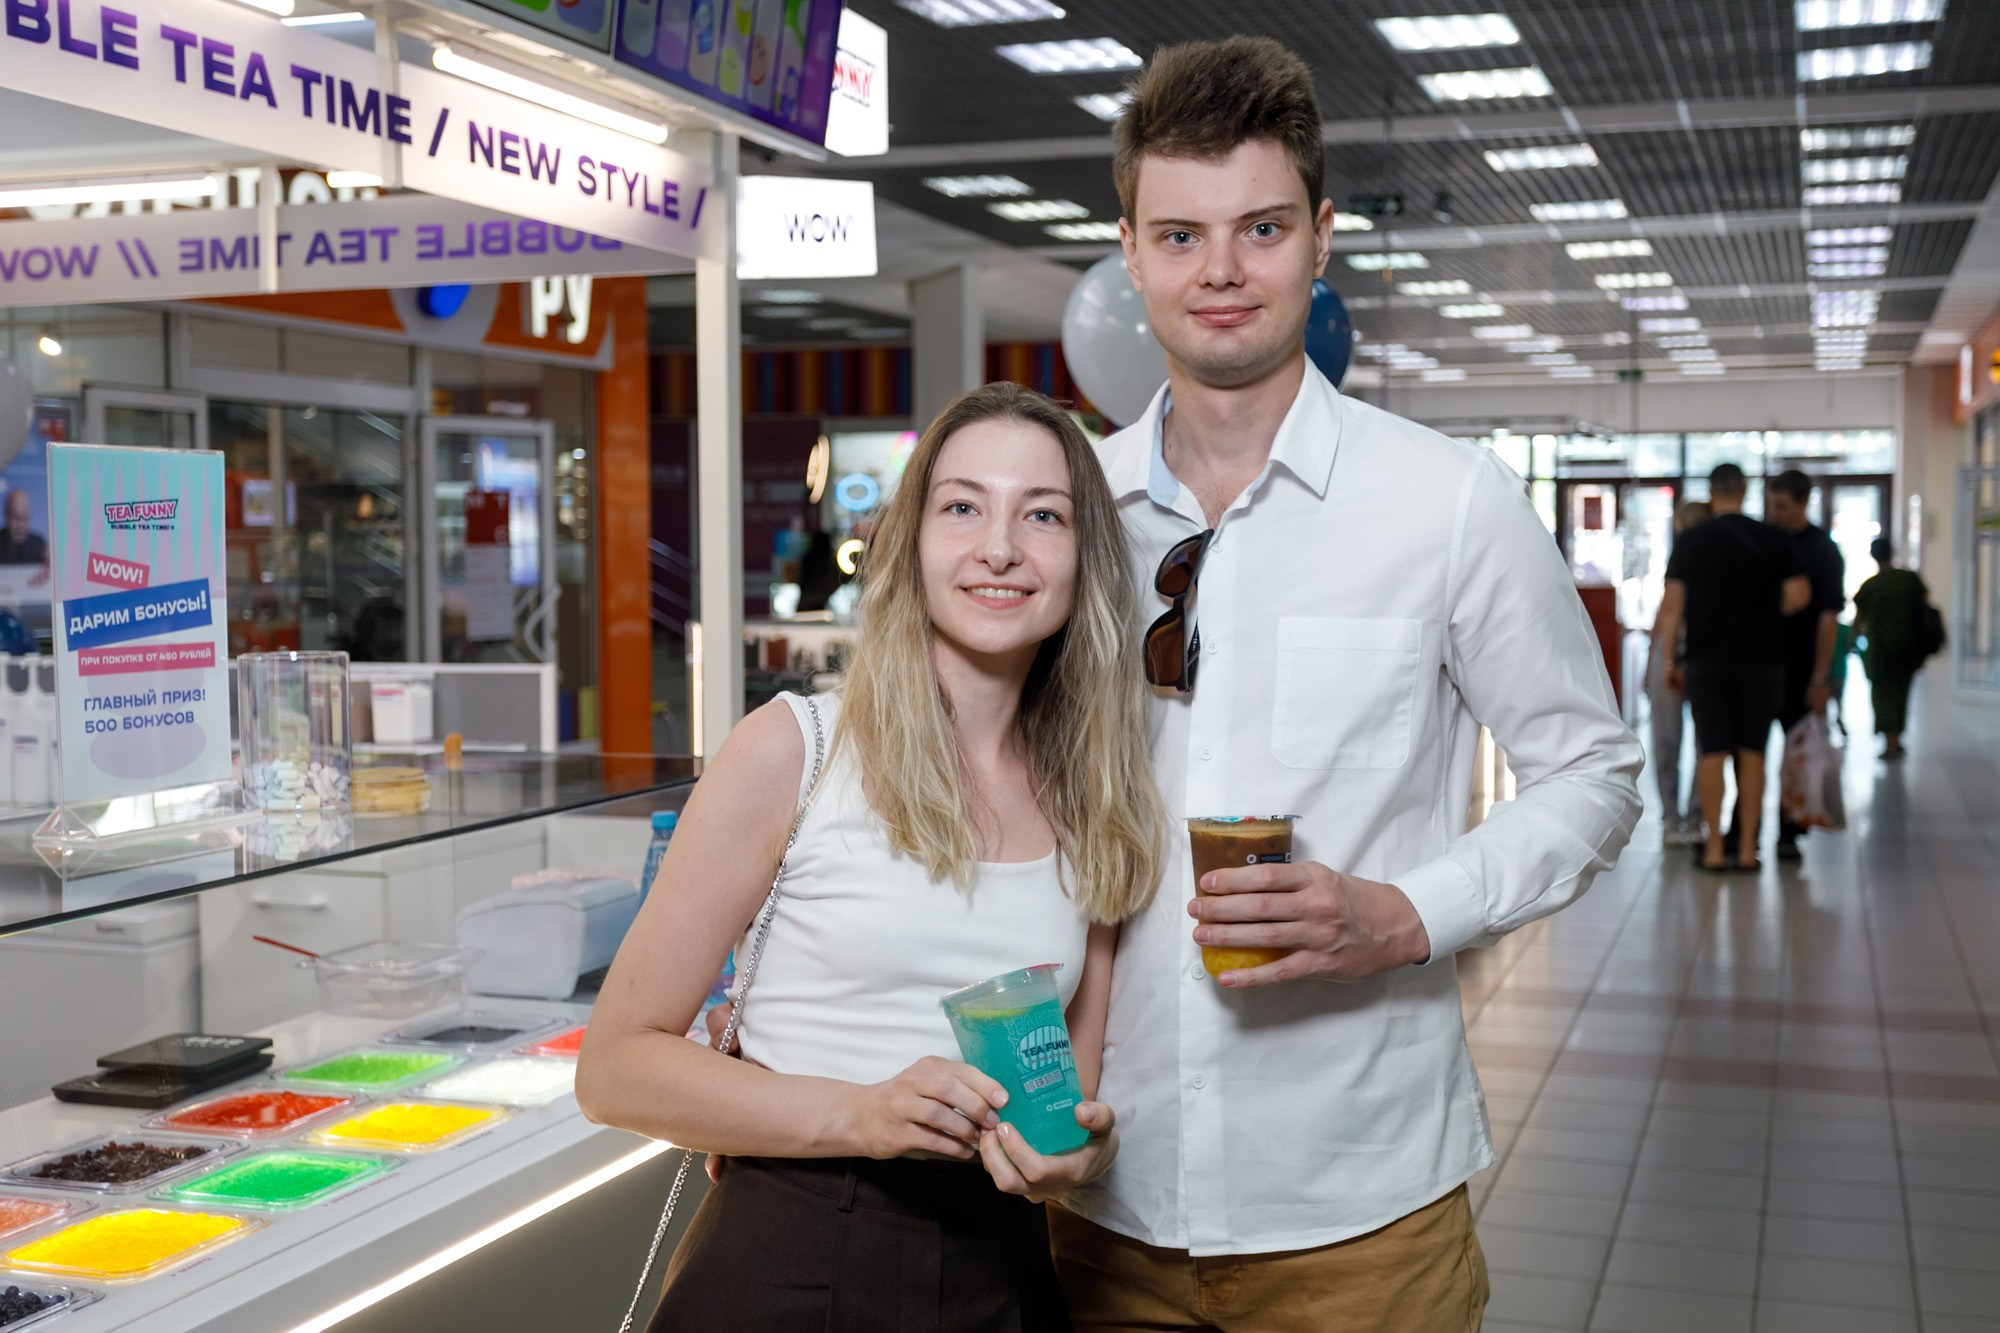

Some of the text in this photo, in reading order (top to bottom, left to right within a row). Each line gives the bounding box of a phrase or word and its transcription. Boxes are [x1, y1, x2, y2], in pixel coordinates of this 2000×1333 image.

[160, 23, 278, 109] TEA
[290, 63, 413, 145] TIME
[468, 120, 561, 185] NEW
[578, 154, 679, 222] STYLE
[107, 502, 175, 520] TEA FUNNY
[92, 558, 144, 585] WOW!
[69, 590, 207, 635] ДАРИМ БОНУСЫ!
[81, 656, 100, 666] ПРИ
[102, 653, 144, 665] ПОКУПКЕ
[146, 653, 158, 662] ОТ
[180, 647, 212, 659] РУБЛЕЙ
[84, 688, 206, 711] ГЛАВНЫЙ ПРИЗ!
[85, 711, 194, 734] 500 БОНУСОВ
[1021, 1044, 1044, 1058] TEA
